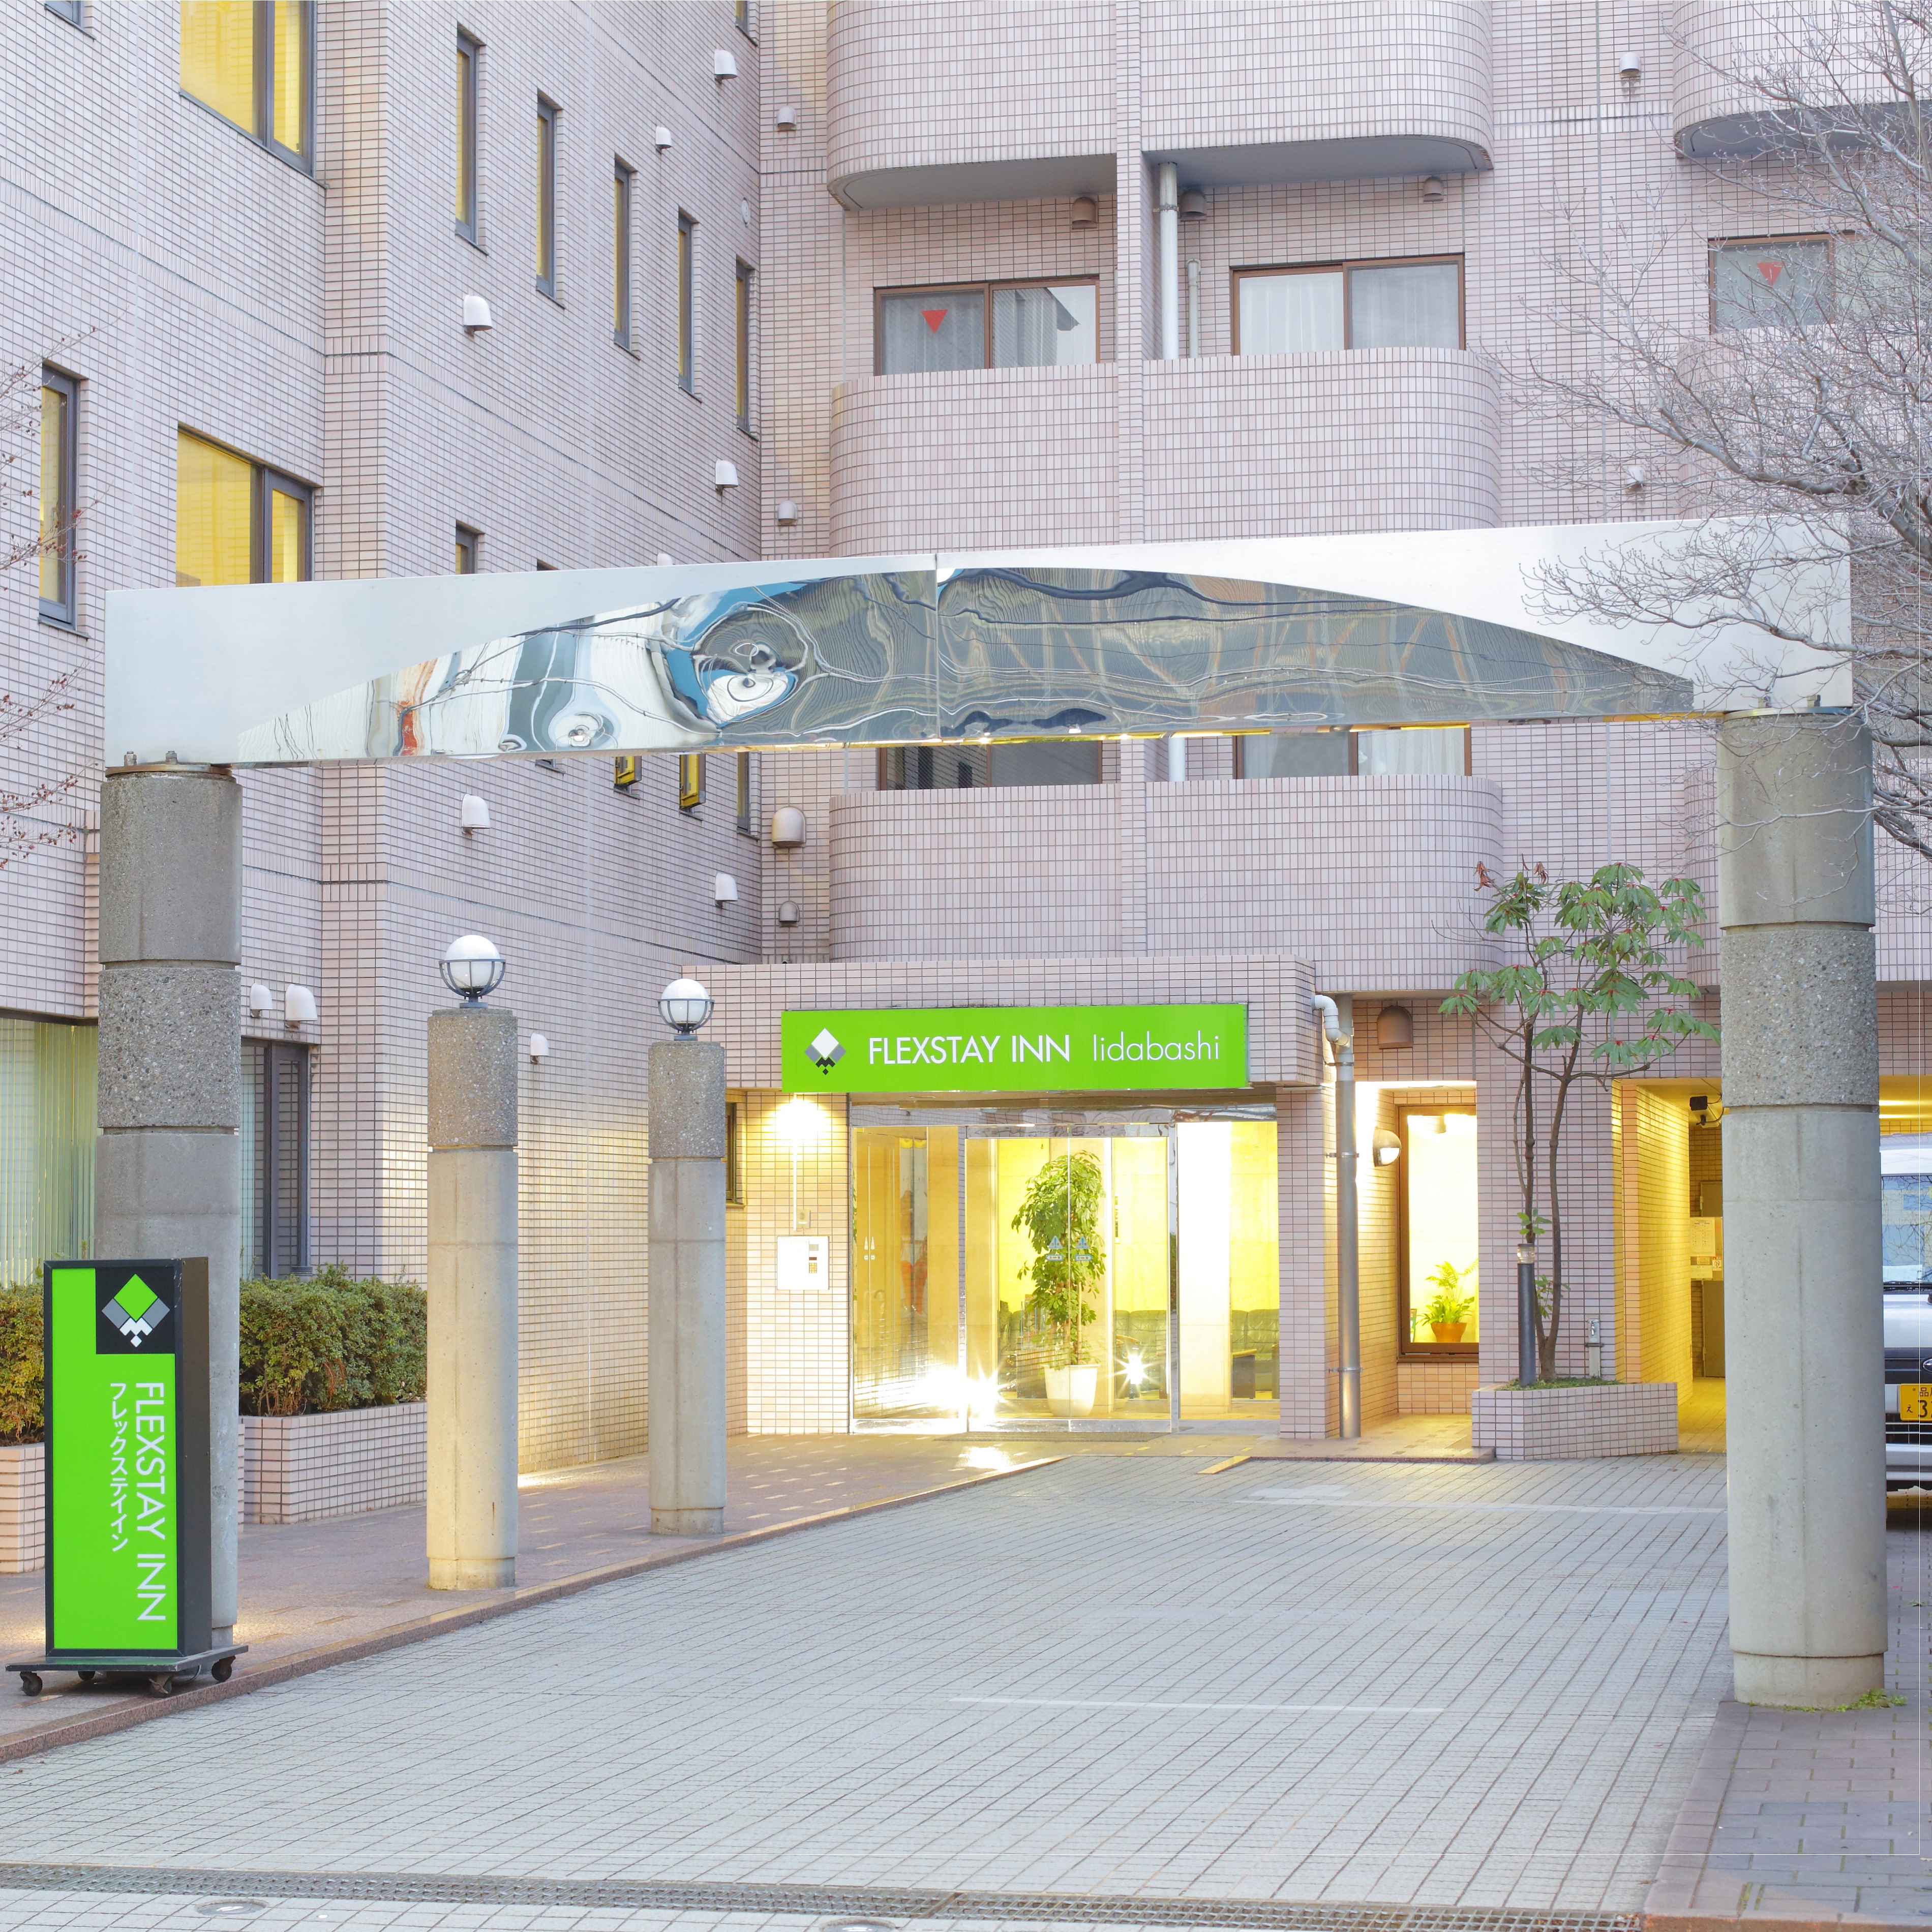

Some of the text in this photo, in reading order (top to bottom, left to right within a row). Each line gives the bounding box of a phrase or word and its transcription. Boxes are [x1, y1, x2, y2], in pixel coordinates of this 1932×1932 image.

[869, 1030, 1219, 1064] FLEXSTAY INN Iidabashi
[1917, 1399, 1932, 1418] 3
[1919, 1387, 1932, 1397] 品
[110, 1382, 129, 1552] フレックステイイン
[135, 1382, 166, 1620] FLEXSTAY INN
